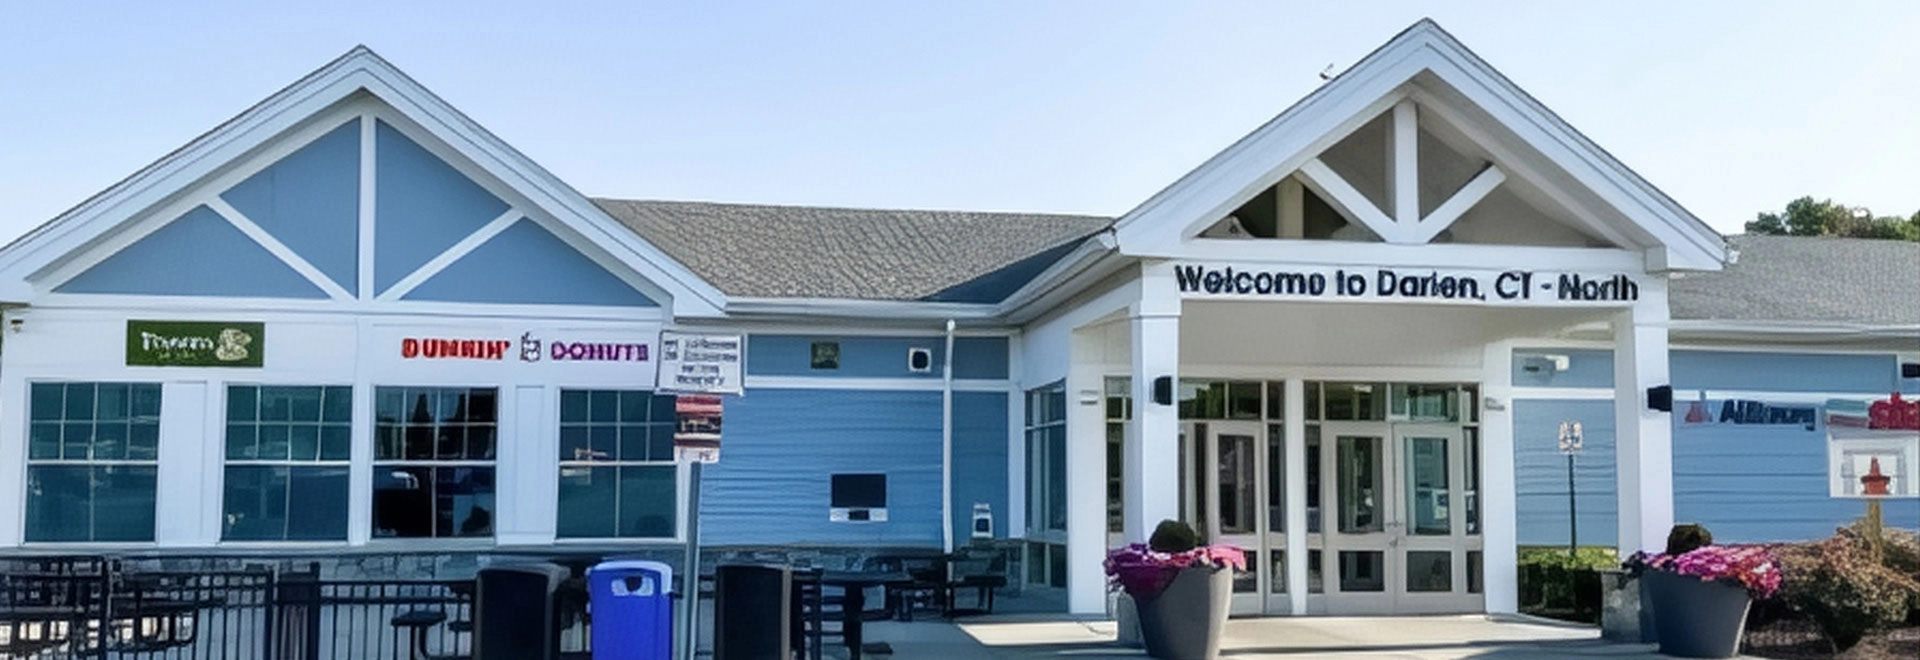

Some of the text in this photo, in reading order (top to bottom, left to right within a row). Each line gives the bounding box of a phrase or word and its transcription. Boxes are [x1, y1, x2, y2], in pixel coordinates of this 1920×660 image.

[1175, 265, 1325, 295] Welcome
[1336, 270, 1366, 296] to
[1495, 272, 1532, 299] CT
[1559, 274, 1638, 301] North
